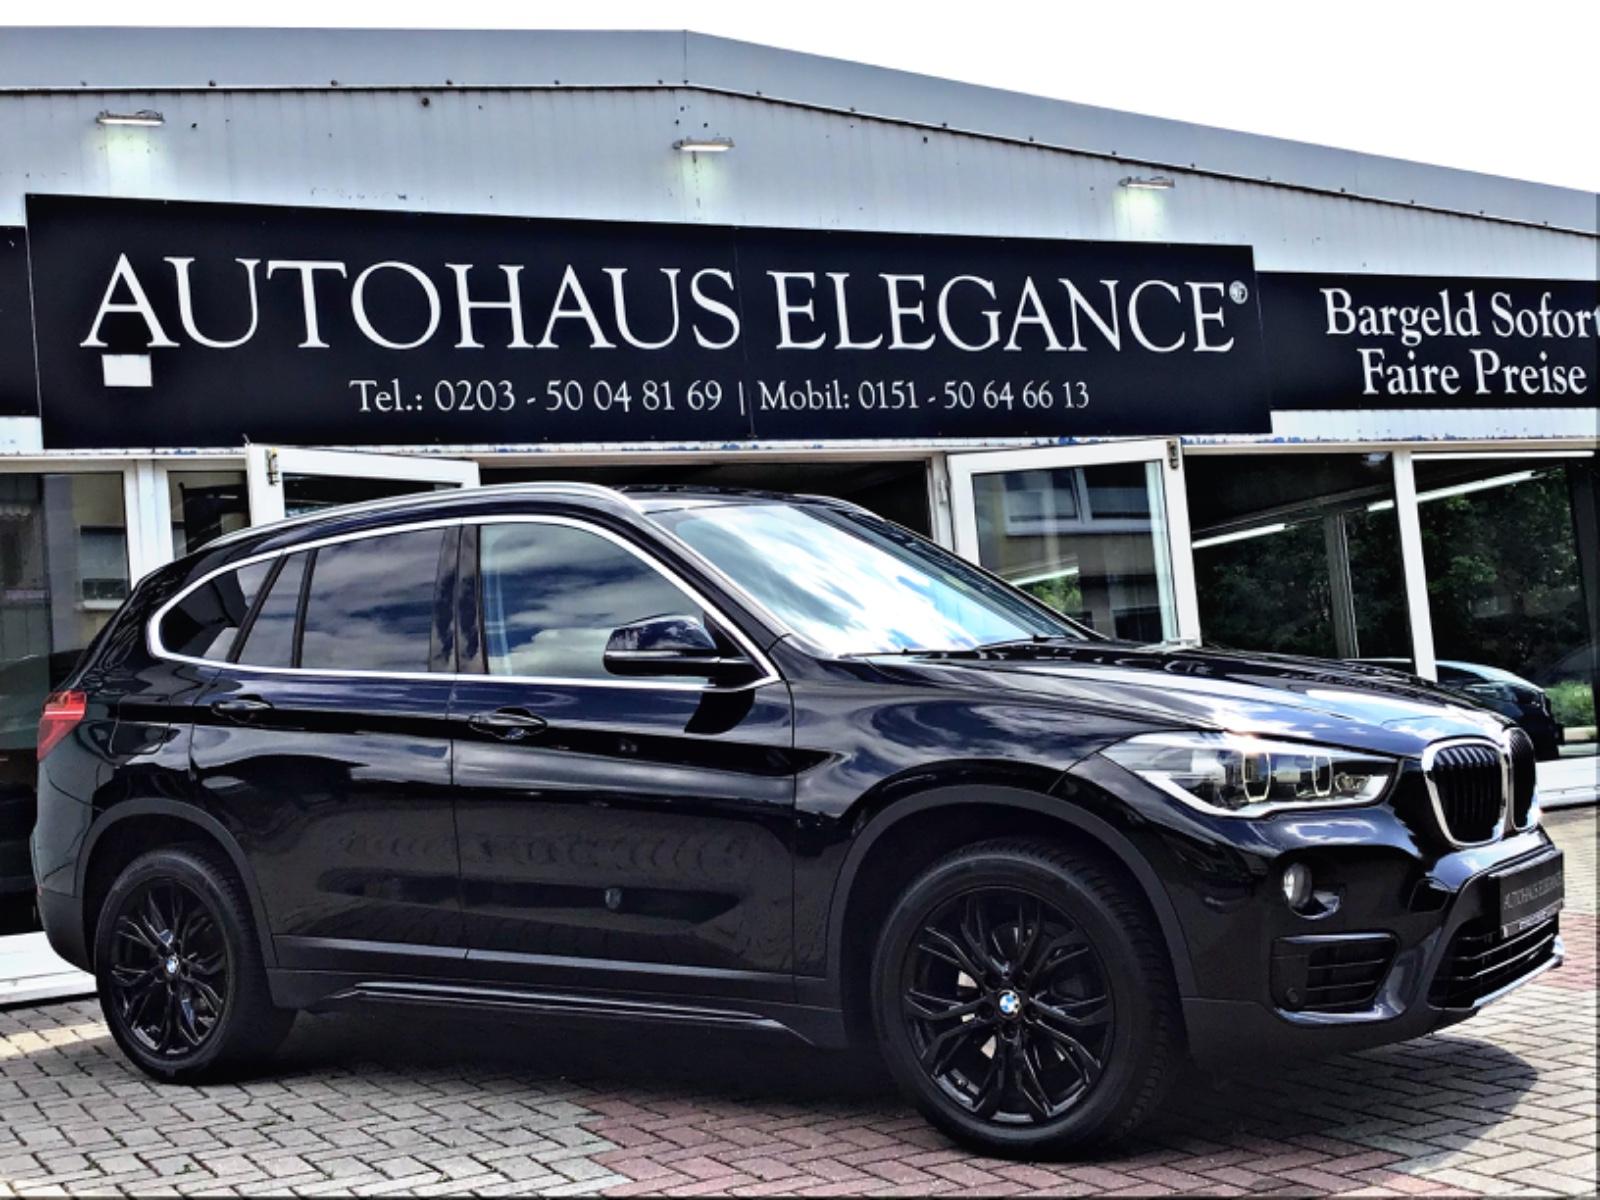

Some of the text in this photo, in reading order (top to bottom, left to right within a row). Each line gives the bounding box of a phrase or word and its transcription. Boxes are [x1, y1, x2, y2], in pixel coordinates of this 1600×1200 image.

[80, 253, 741, 351] AUTOHAUS
[1319, 287, 1481, 346] Bargeld
[349, 379, 424, 412] Tel.:
[434, 379, 516, 412] 0203
[546, 379, 584, 412] 50
[593, 380, 633, 413] 04
[642, 380, 676, 411] 81
[687, 379, 723, 412] 69
[757, 379, 850, 411] Mobil:
[858, 380, 920, 410] 0151
[944, 380, 976, 410] 50
[983, 380, 1015, 411] 64
[1022, 380, 1054, 410] 66
[1061, 380, 1090, 410] 13
[1356, 348, 1588, 395] Faire Preise
